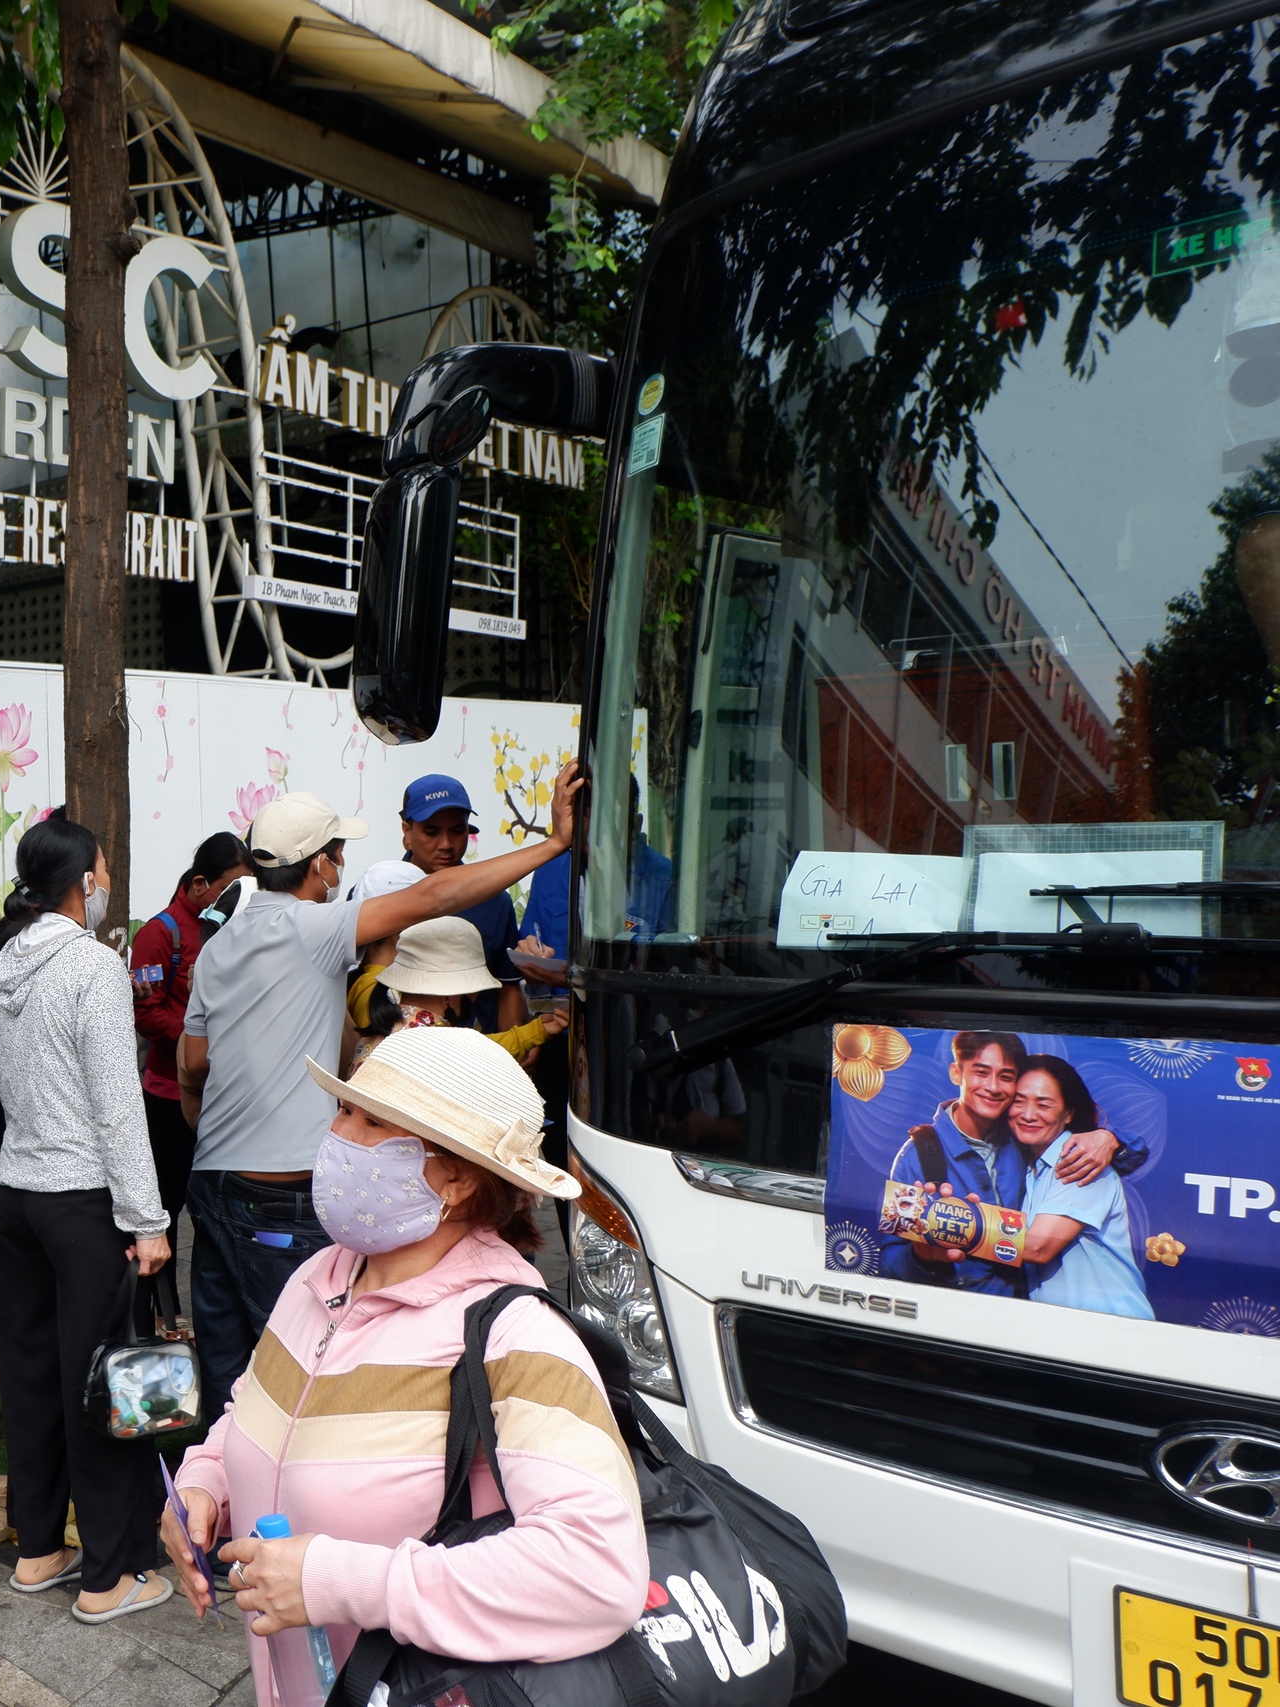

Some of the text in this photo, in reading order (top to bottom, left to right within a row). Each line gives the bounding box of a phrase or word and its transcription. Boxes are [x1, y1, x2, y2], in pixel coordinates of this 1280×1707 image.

[1168, 232, 1205, 261] XE
[261, 313, 329, 418] ẨM
[524, 428, 585, 491] NAM
[275, 583, 298, 602] Phạm
[301, 588, 321, 606] Ngọc
[425, 790, 449, 802] KIWI
[1184, 1172, 1280, 1223] TP.
[934, 1202, 973, 1220] MANG
[936, 1216, 969, 1235] TẾT
[946, 1234, 969, 1247] NHÀ
[996, 1245, 1016, 1255] PEPSI
[741, 1270, 918, 1320] UNIVERSE
[1194, 1615, 1280, 1684] 50
